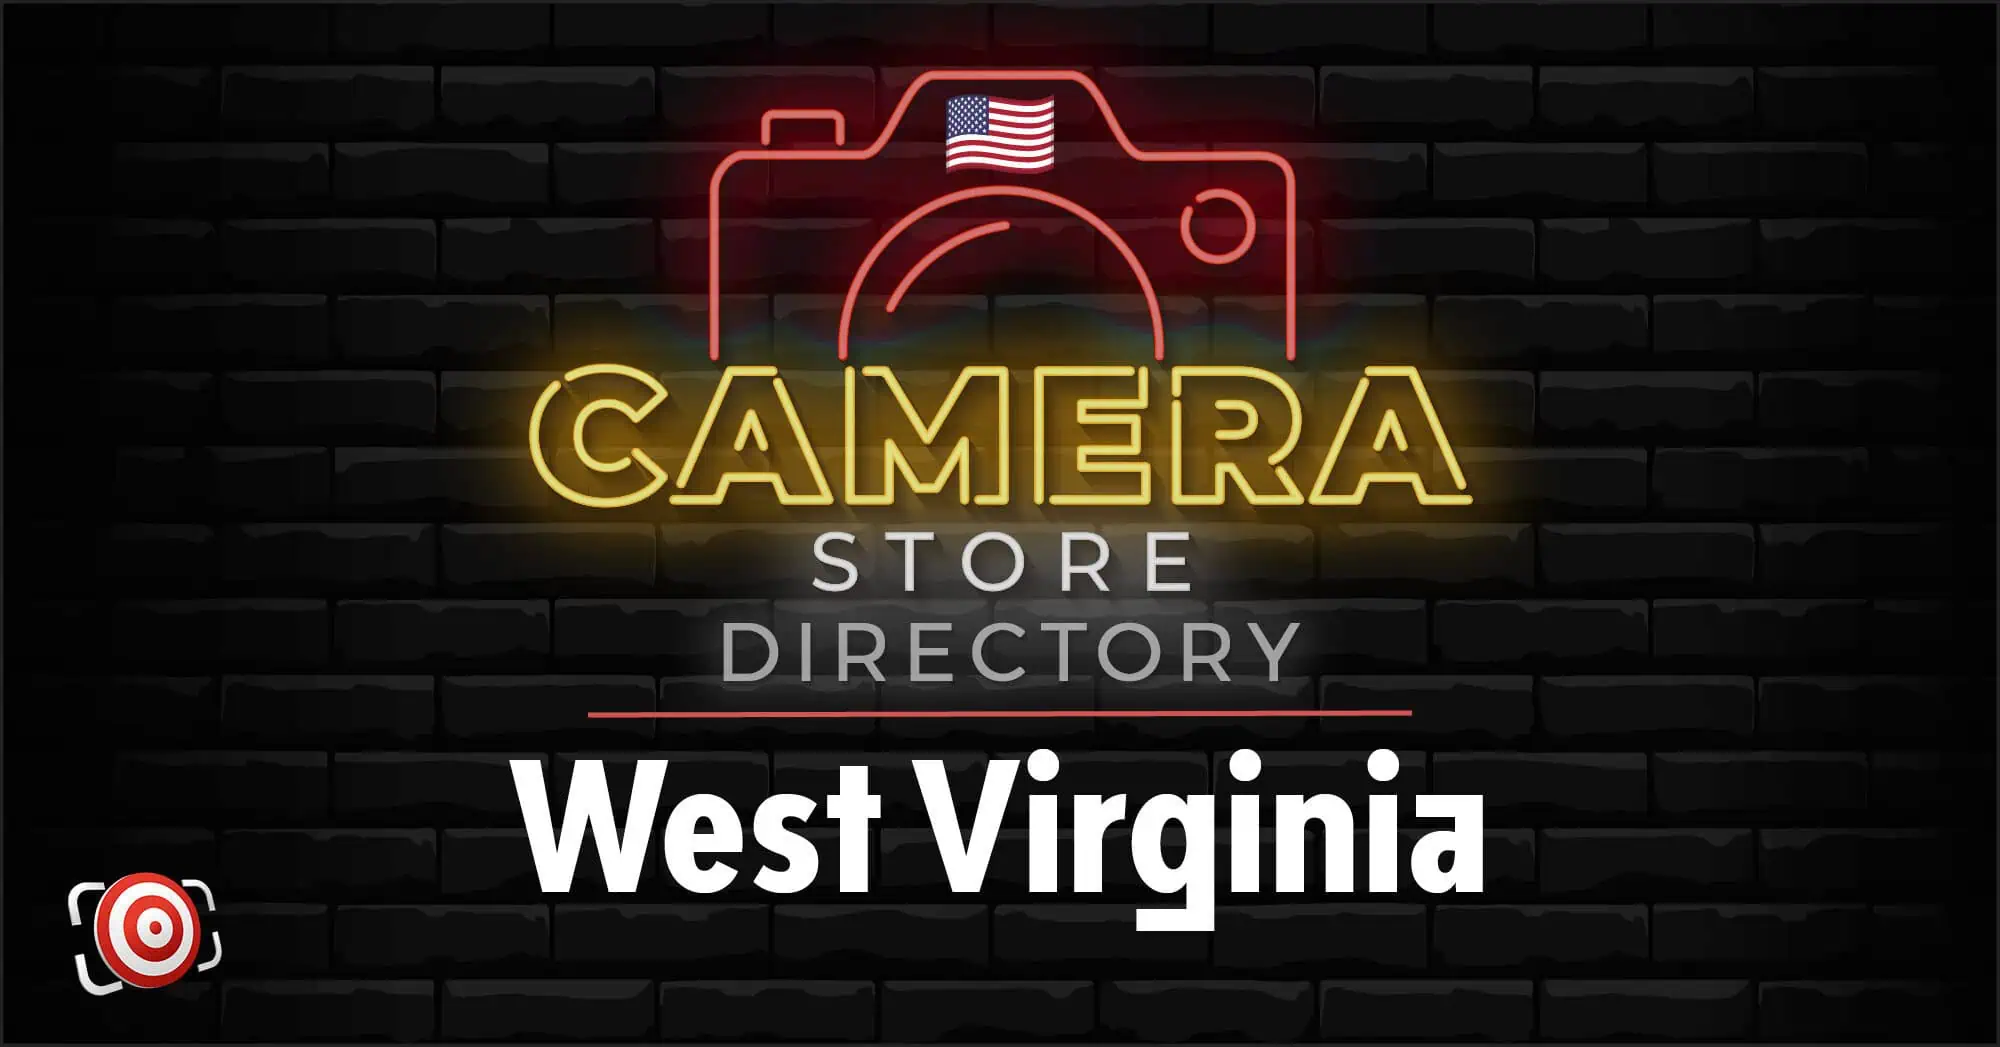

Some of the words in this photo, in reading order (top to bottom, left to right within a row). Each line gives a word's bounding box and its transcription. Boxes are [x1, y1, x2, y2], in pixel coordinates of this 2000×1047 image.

[529, 363, 1474, 507] CAMERA
[813, 532, 1191, 592] STORE
[723, 622, 1301, 682] DIRECTORY
[509, 759, 882, 894] West
[912, 748, 1484, 932] Virginia
